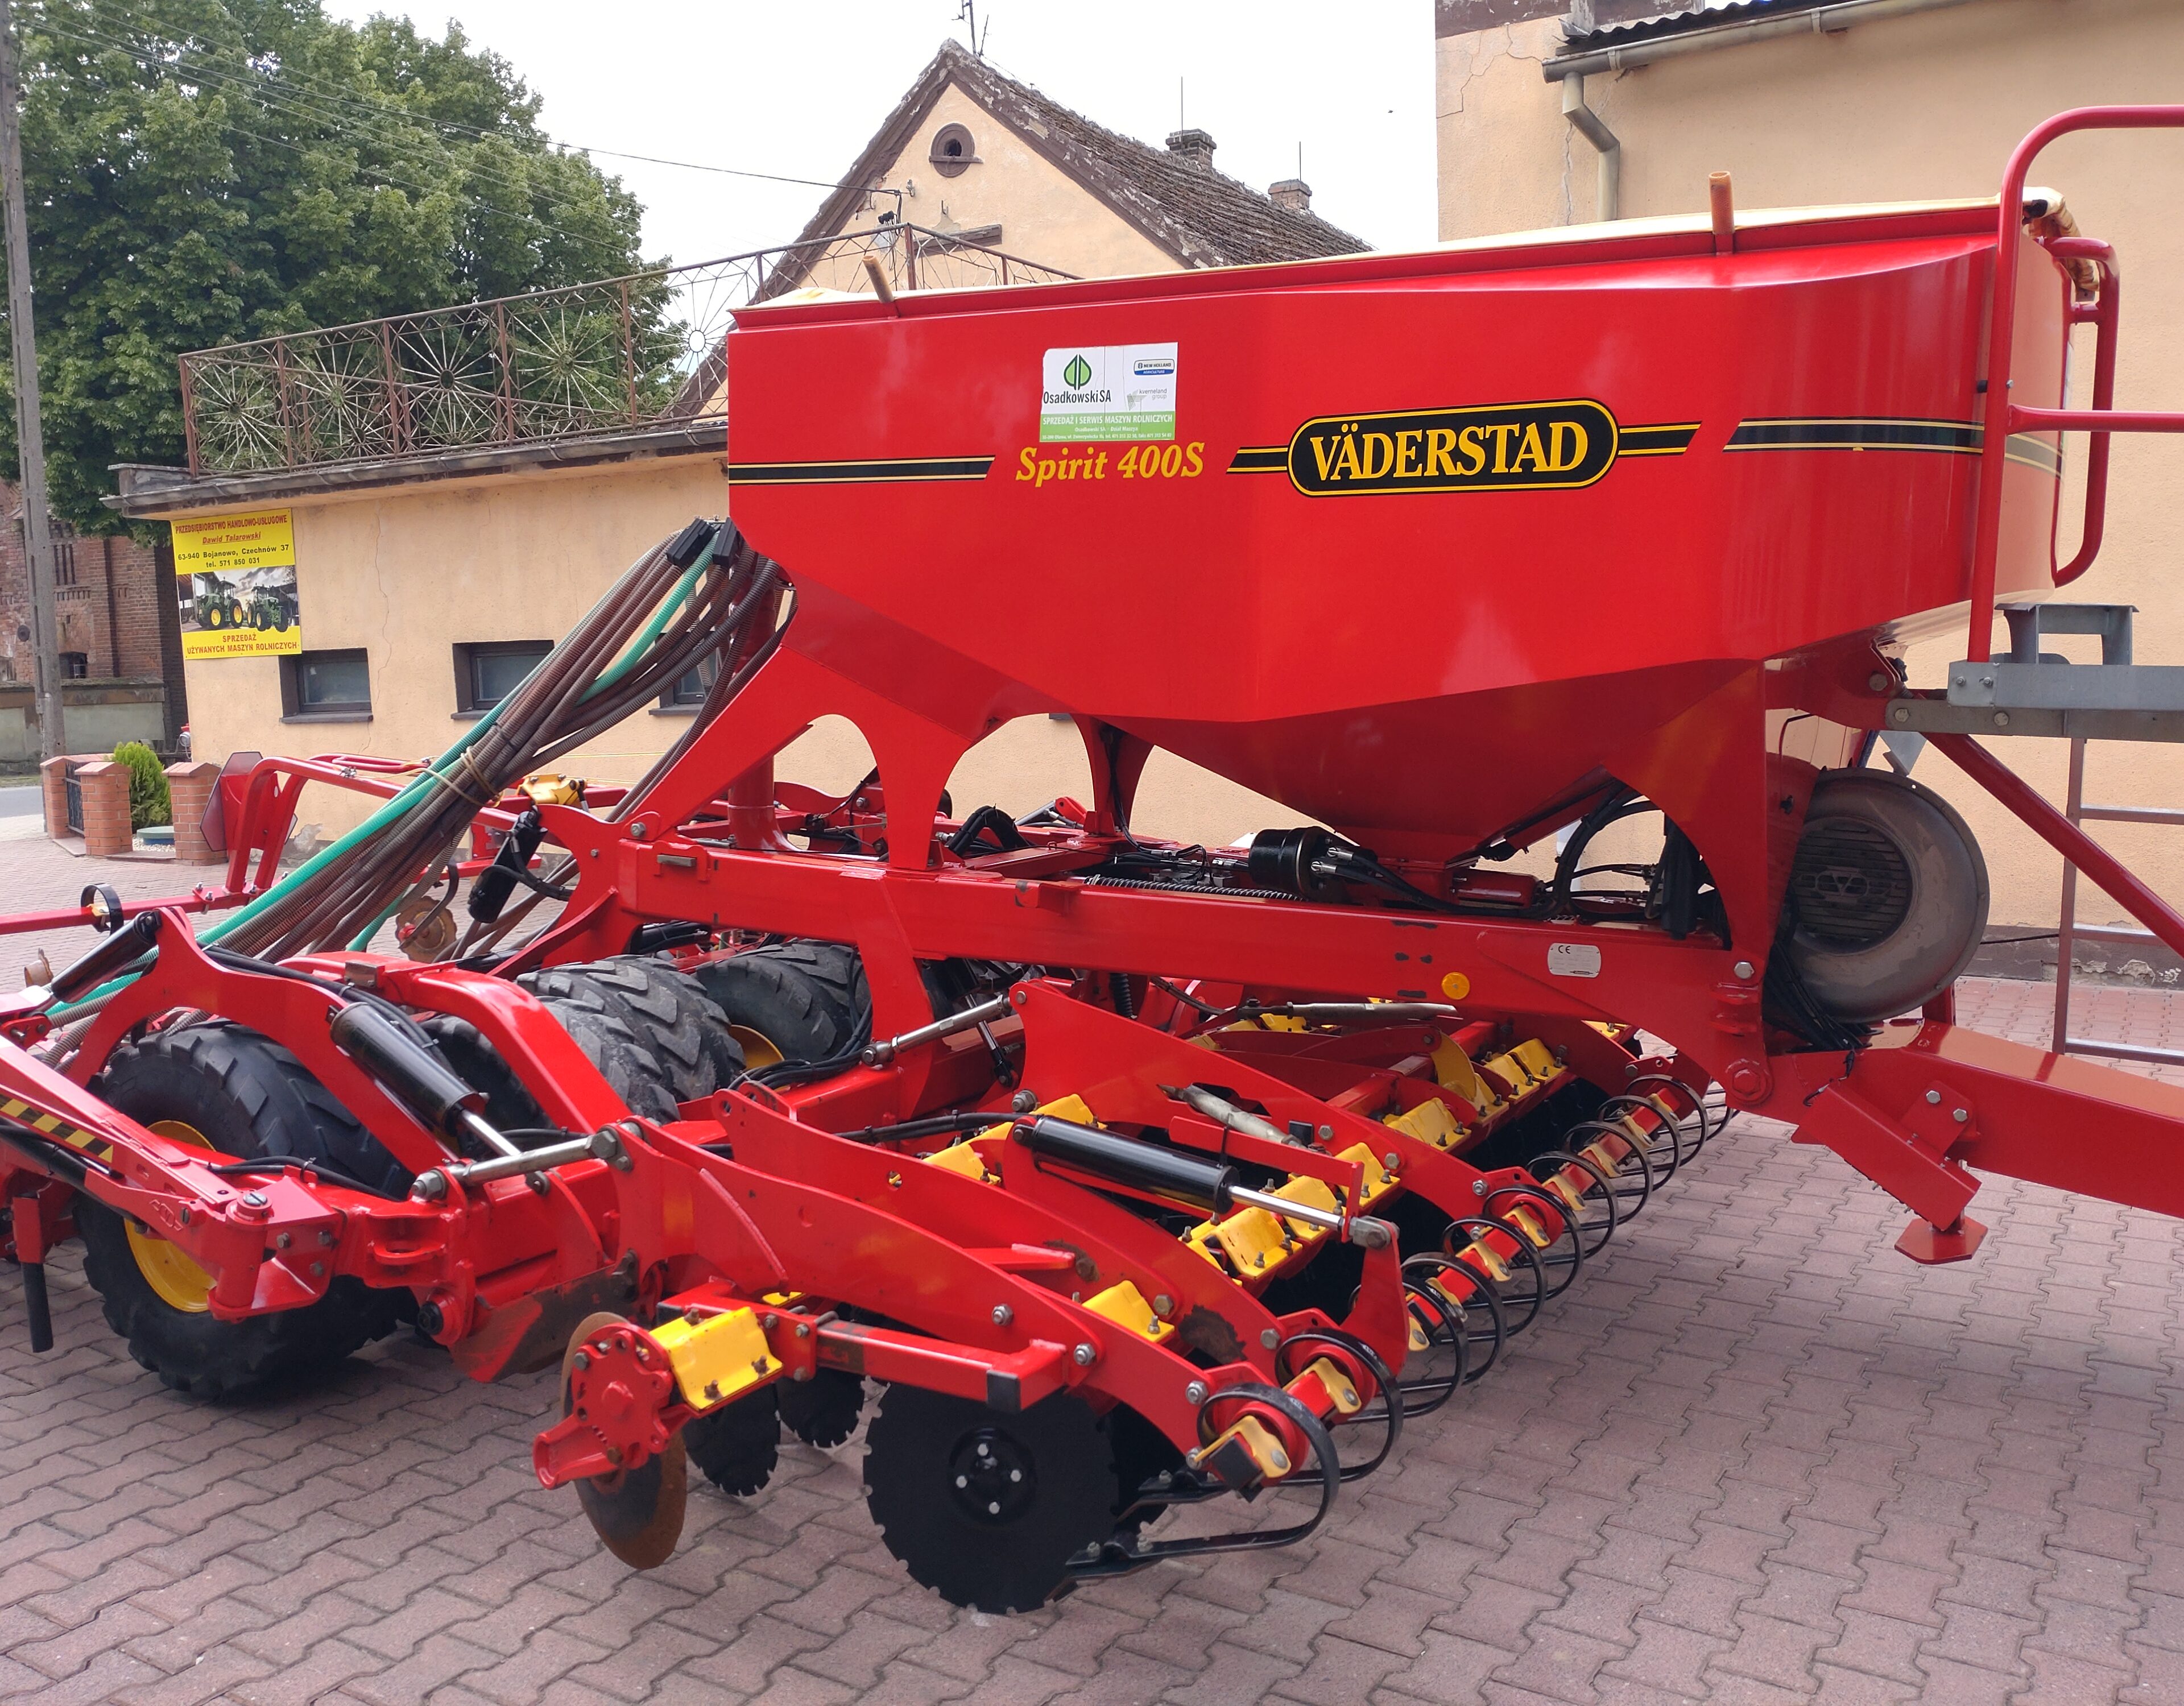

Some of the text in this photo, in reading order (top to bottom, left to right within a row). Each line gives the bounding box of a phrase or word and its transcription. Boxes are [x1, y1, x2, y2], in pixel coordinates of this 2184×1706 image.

[1043, 415, 1074, 425] SPRZEDAŻ
[1105, 415, 1131, 424] MASZYN
[1310, 421, 1589, 481] VÄDERSTAD
[1015, 441, 1205, 487] Spirit 400S
[175, 515, 287, 534] PRZEDSIĘBIORSTWO HANDLOWO-USŁUGOWE
[202, 532, 261, 544] Dawid Talarowski
[242, 546, 277, 554] Czechnów
[222, 632, 257, 643] SPRZEDAŻ
[187, 641, 297, 654] UŻYWANYCH MASZYN ROLNICZYCH
